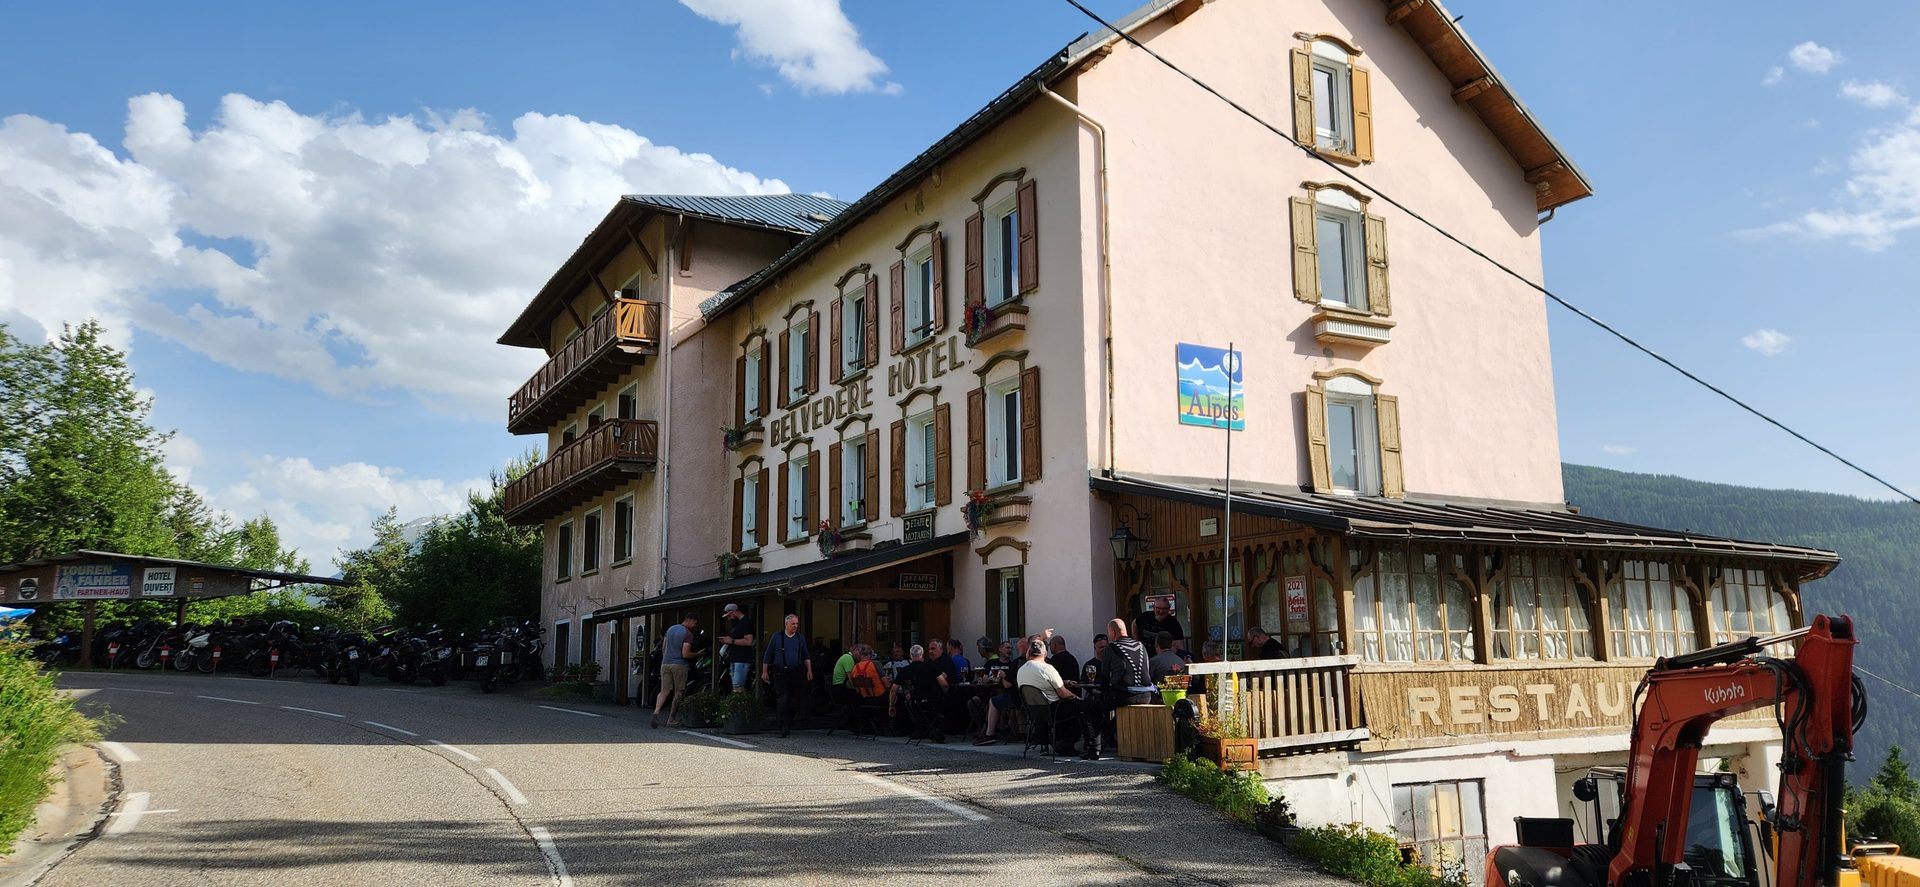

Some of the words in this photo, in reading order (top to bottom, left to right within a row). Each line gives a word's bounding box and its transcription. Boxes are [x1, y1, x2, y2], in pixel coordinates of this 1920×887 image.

[770, 375, 874, 447] BELVEDERE
[888, 335, 965, 396] HOTEL
[1186, 388, 1239, 425] Alpes
[904, 530, 931, 541] MOTARDS
[63, 565, 118, 576] TOUREN-
[147, 571, 172, 581] HOTEL
[78, 575, 129, 586] FAHRER
[1287, 580, 1304, 590] 2021
[77, 588, 129, 596] PARTNER-HAUS
[144, 582, 174, 592] OUVERT
[1704, 682, 1745, 704] Kubota
